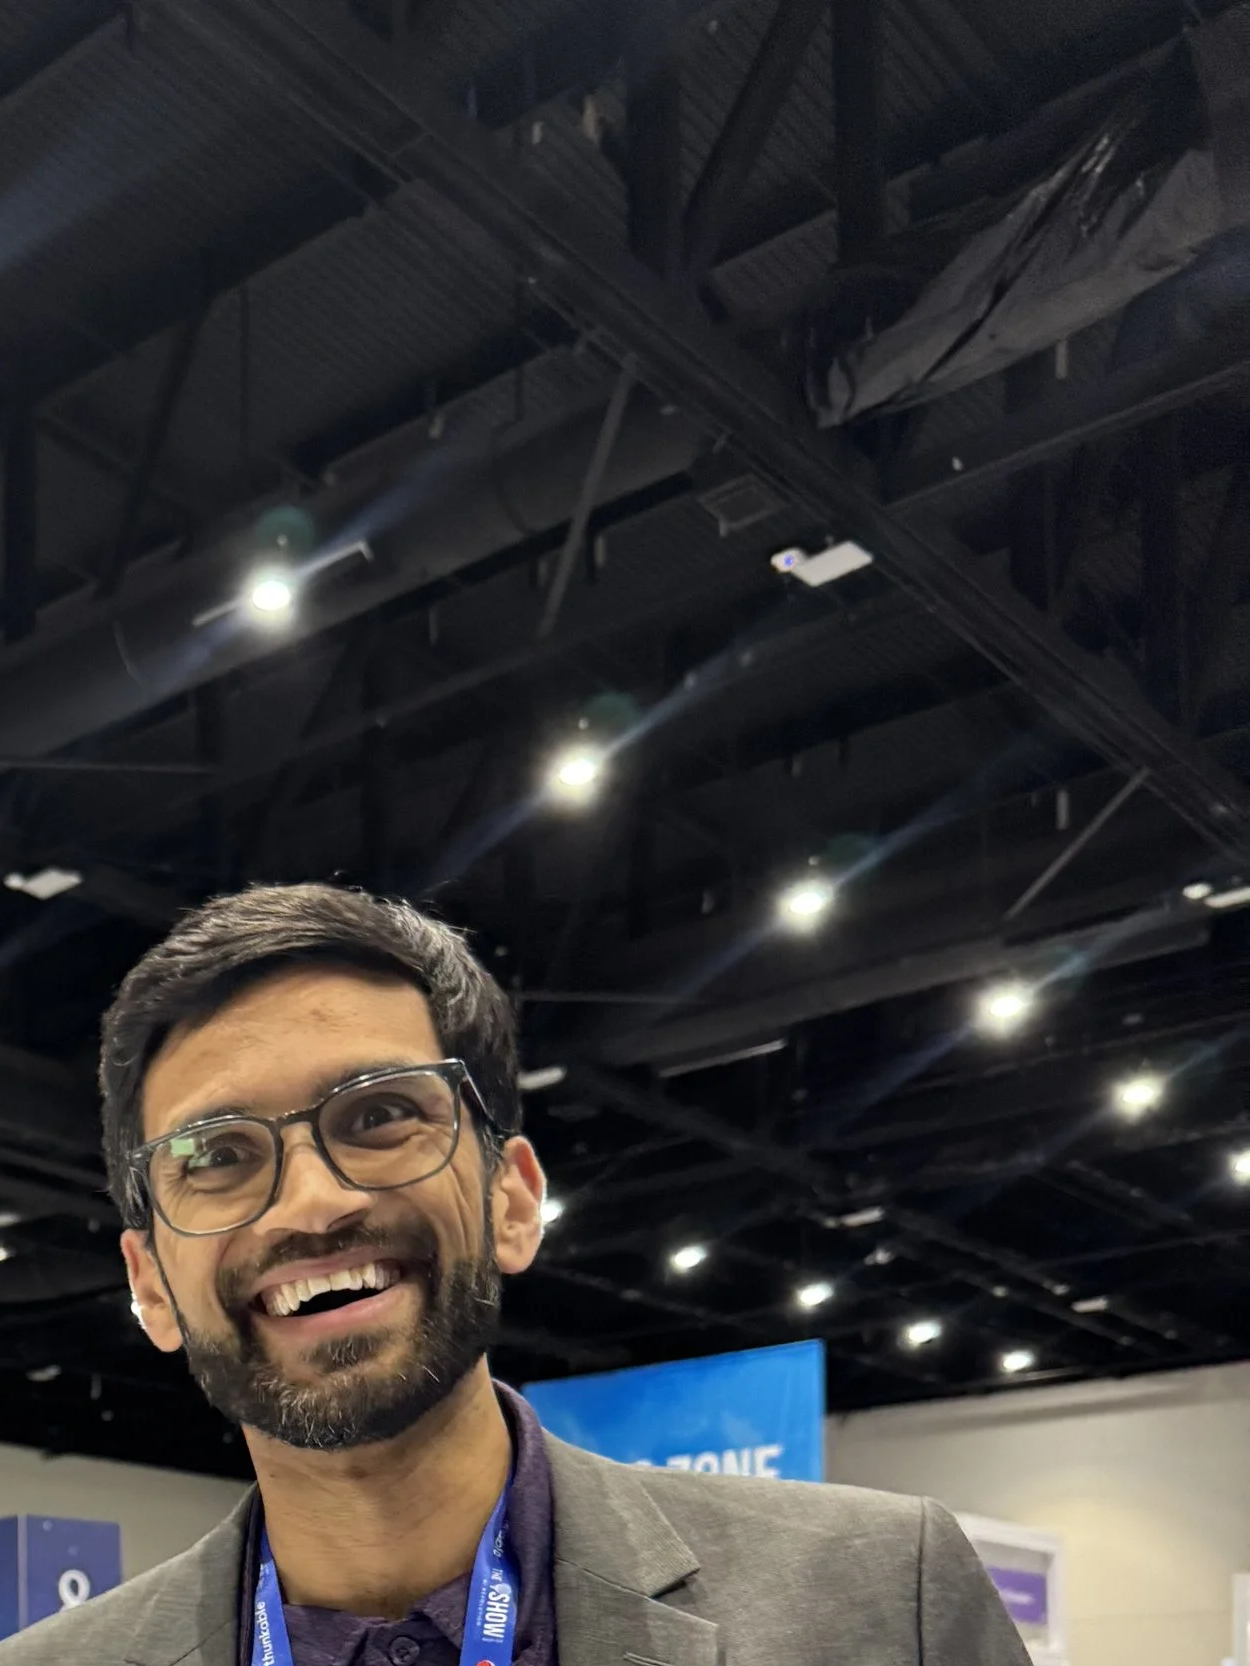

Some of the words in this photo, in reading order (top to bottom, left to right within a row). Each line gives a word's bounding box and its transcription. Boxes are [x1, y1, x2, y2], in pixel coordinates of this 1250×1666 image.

[491, 1569, 503, 1581] THE
[256, 1601, 275, 1666] thunkable
[483, 1593, 510, 1639] SHOW
